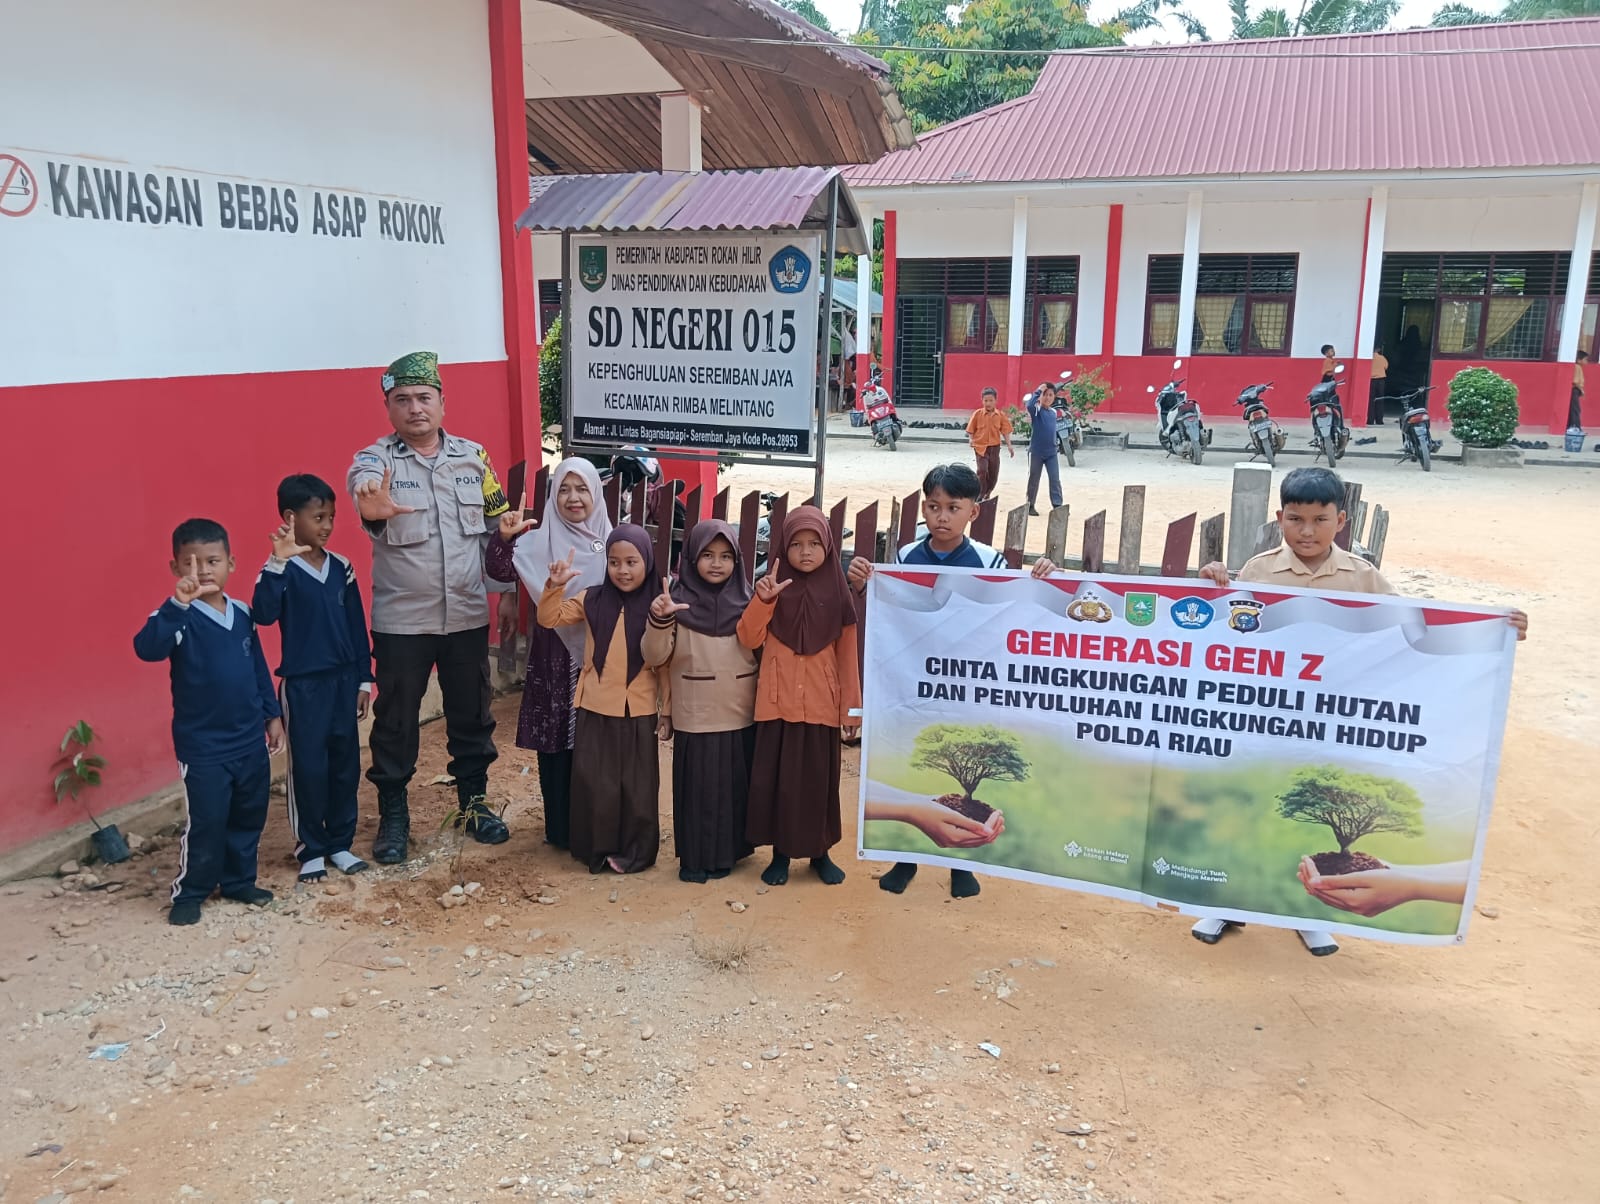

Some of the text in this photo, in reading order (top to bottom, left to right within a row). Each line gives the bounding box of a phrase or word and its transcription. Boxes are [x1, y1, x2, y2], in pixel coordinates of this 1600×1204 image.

[47, 162, 445, 244] KAWASAN BEBAS ASAP ROKOK
[616, 246, 762, 264] PEMERINTAH KABUPATEN ROKAN HILIR
[611, 274, 767, 293] DINAS PENDIDIKAN DAN KEBUDAYAAN
[588, 305, 796, 354] SD NEGERI 015
[588, 362, 794, 387] KEPENGHULUAN SEREMBAN JAYA
[604, 392, 775, 418] KECAMATAN RIMBA MELINTANG
[619, 425, 640, 438] Lintas
[690, 429, 724, 443] Seremban
[724, 431, 741, 447] Jaya
[742, 432, 761, 446] Kode
[1006, 629, 1325, 682] GENERASI GEN Z
[925, 656, 1421, 725] CINTA LINGKUNGAN PEDULI HUTAN
[917, 681, 1427, 753] DAN PENYULUHAN LINGKUNGAN HIDUP
[1076, 722, 1232, 758] POLDA RIAU
